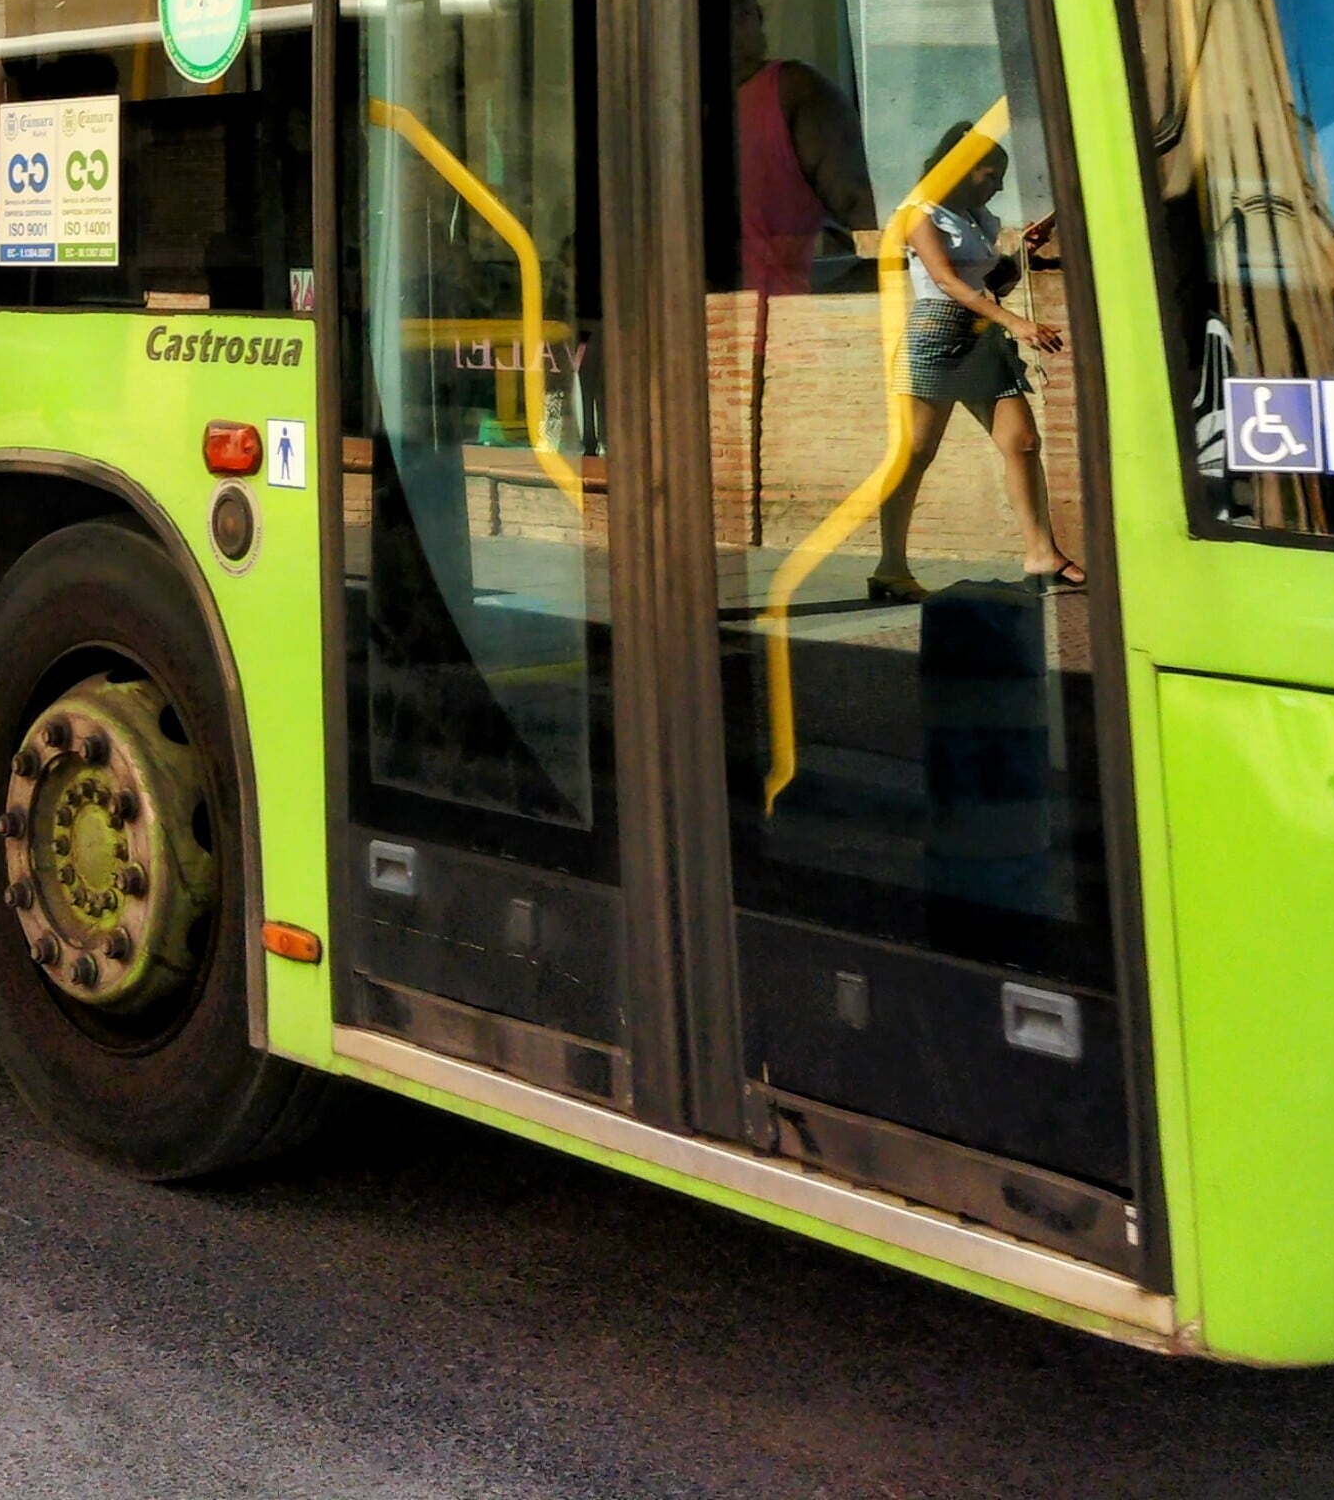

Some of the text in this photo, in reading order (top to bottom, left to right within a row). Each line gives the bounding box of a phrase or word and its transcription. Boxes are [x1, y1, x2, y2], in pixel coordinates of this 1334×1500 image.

[8, 222, 48, 236] ISO 9001
[64, 221, 111, 236] ISO 14001
[146, 325, 304, 367] Castrosua
